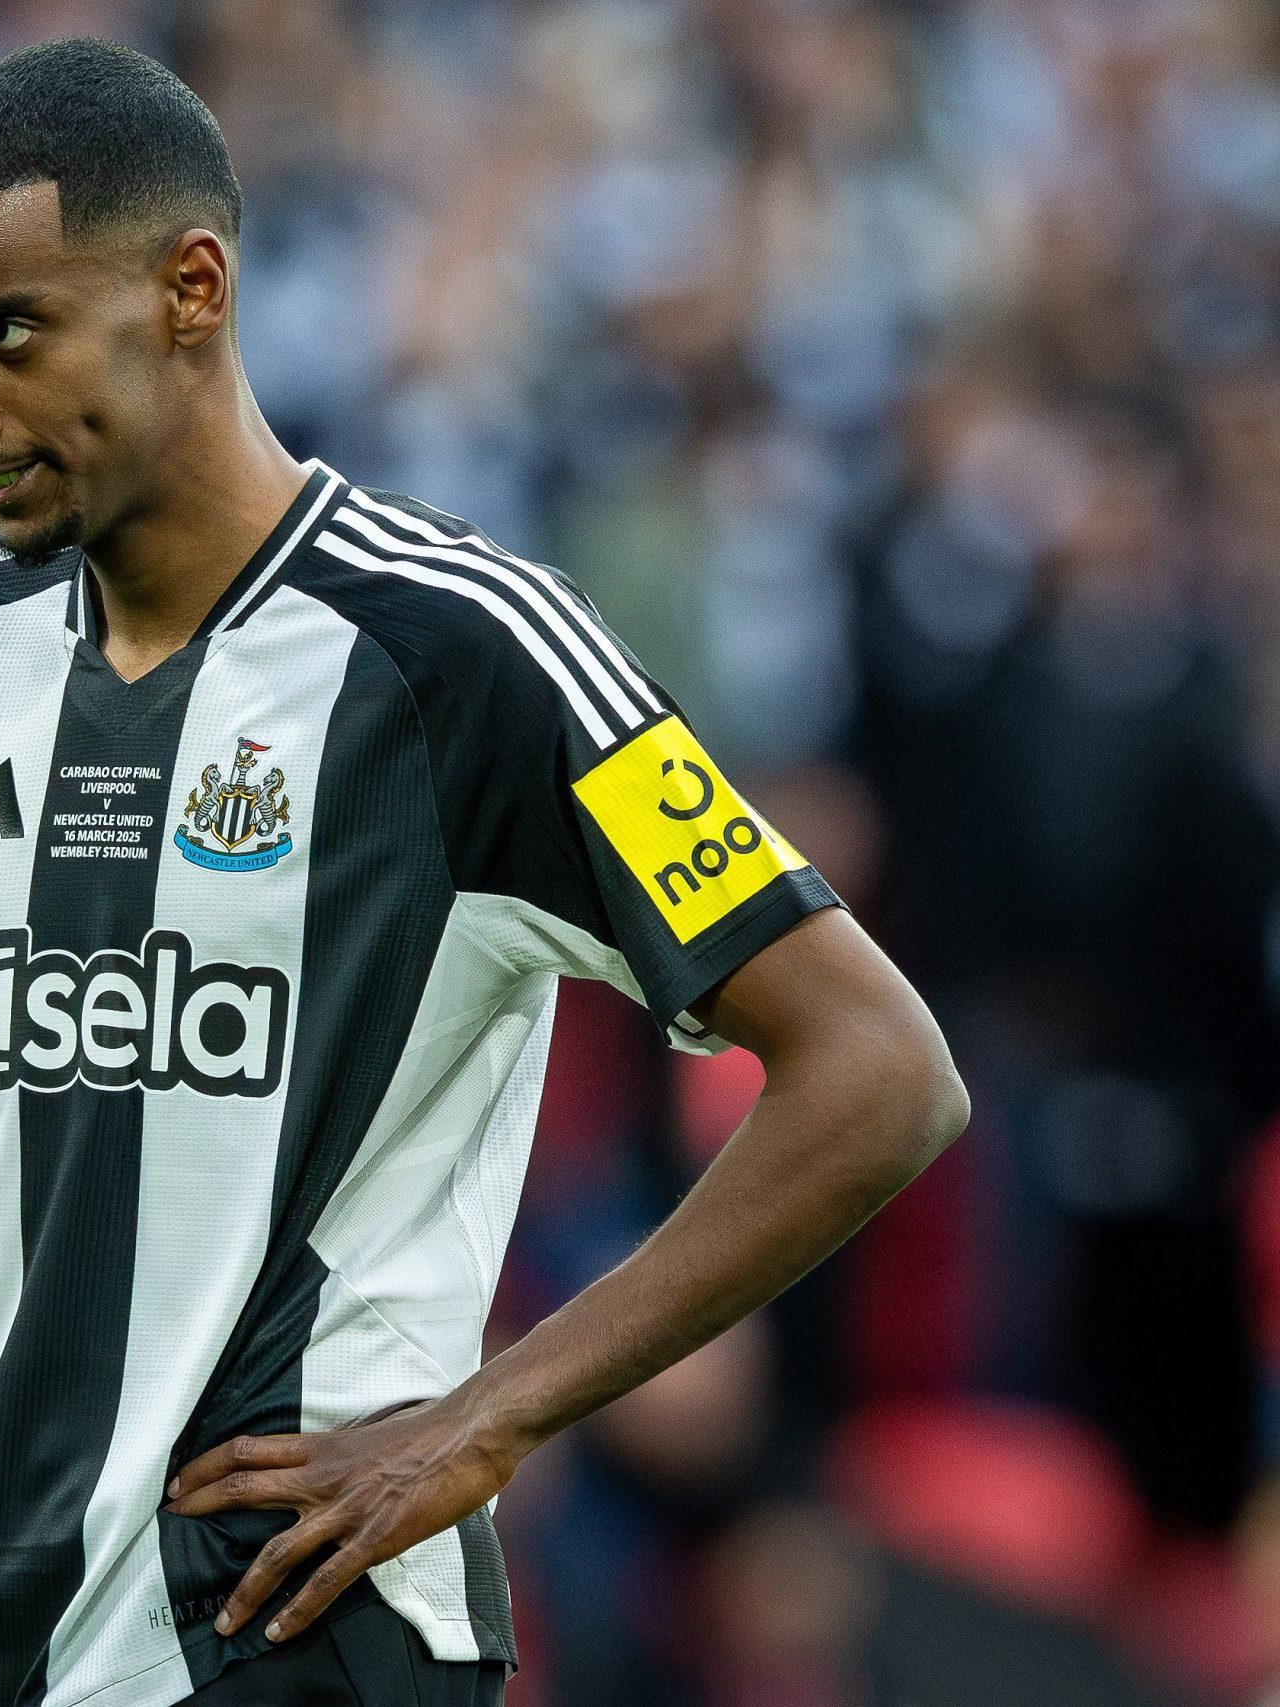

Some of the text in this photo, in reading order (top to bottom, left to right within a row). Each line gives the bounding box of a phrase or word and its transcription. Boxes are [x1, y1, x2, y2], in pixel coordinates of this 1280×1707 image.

[60, 766, 162, 780] CARABAO CUP FINAL
[80, 782, 137, 795] LIVERPOOL
[103, 798, 112, 810] V
[53, 814, 154, 827] NEWCASTLE UNITED
[64, 830, 141, 843] 16 MARCH 2025
[50, 846, 148, 859] WEMBLEY STADIUM
[186, 848, 275, 868] NEWCASTLE UNITED
[653, 816, 776, 907] noo
[21, 948, 272, 1079] sela
